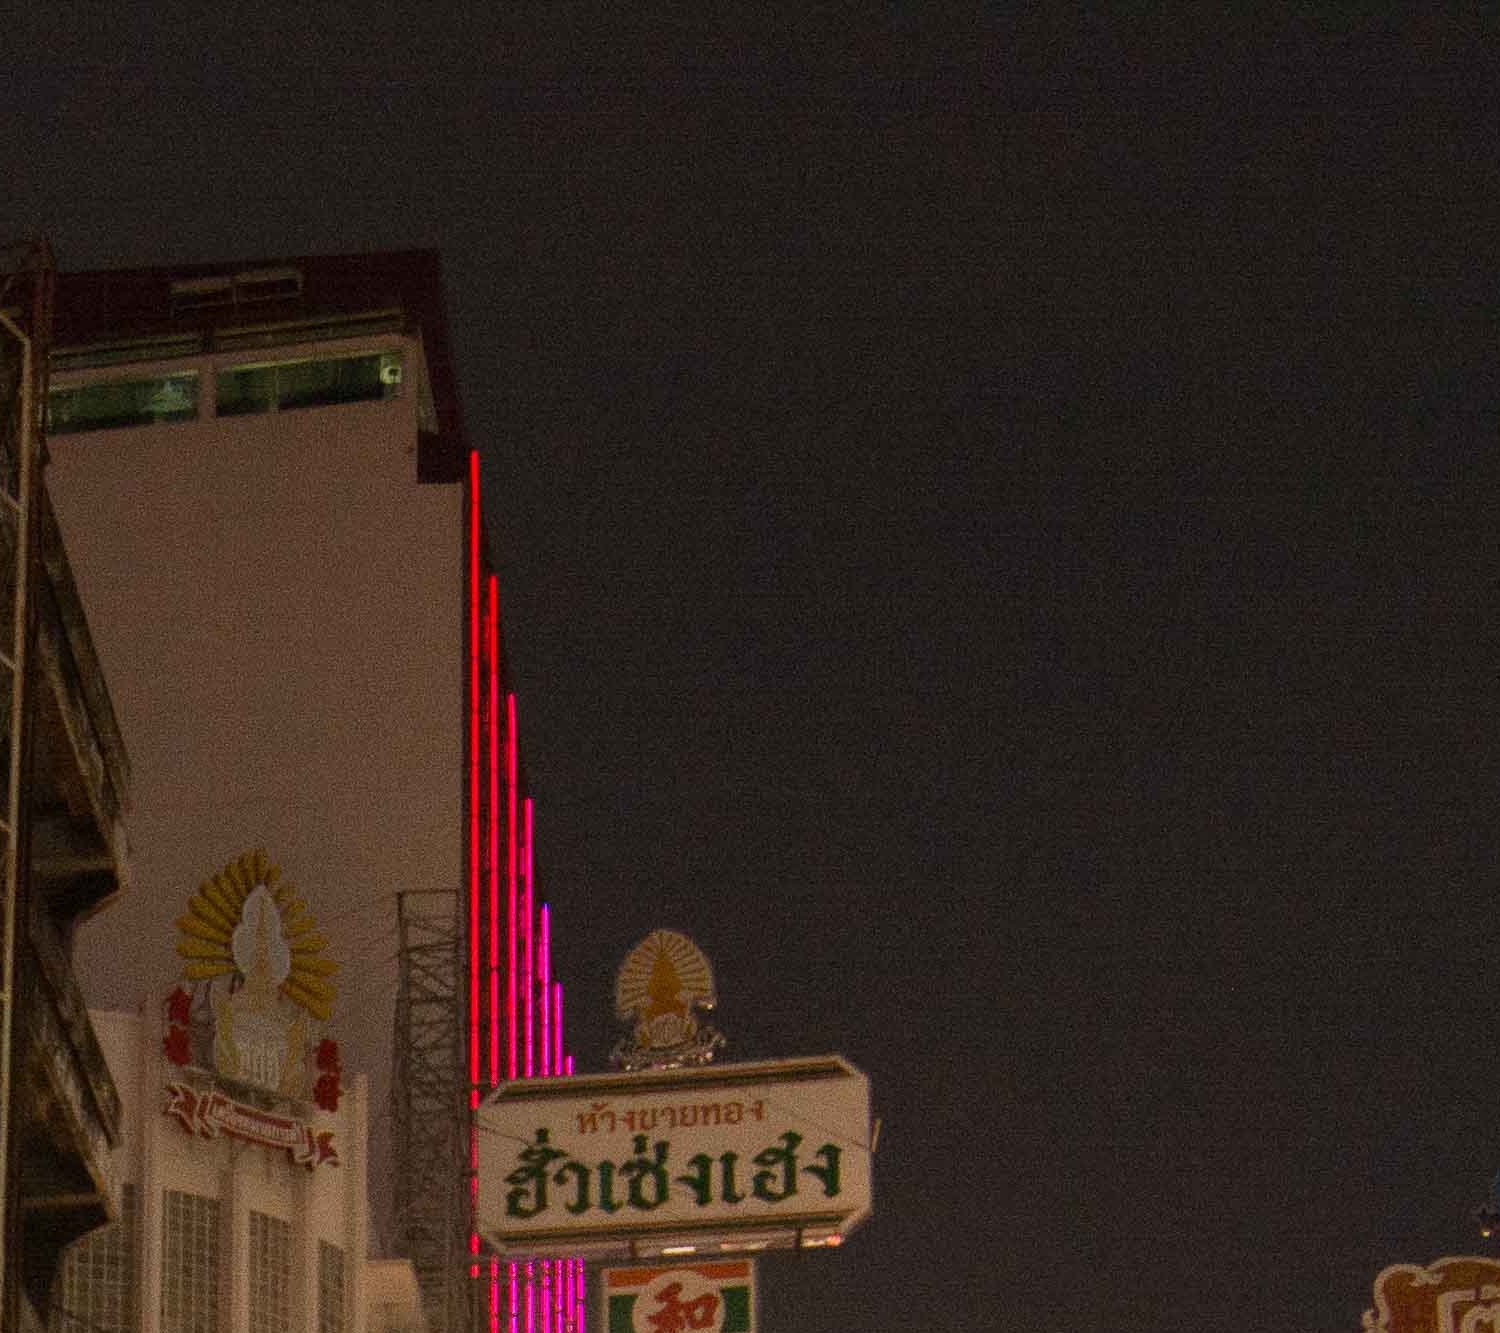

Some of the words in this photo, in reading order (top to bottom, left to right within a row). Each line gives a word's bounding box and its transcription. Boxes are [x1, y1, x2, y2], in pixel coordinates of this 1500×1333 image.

[576, 1100, 765, 1135] ห้างขายทอง
[504, 1127, 842, 1219] ฮั่วเซ่งเฮง
